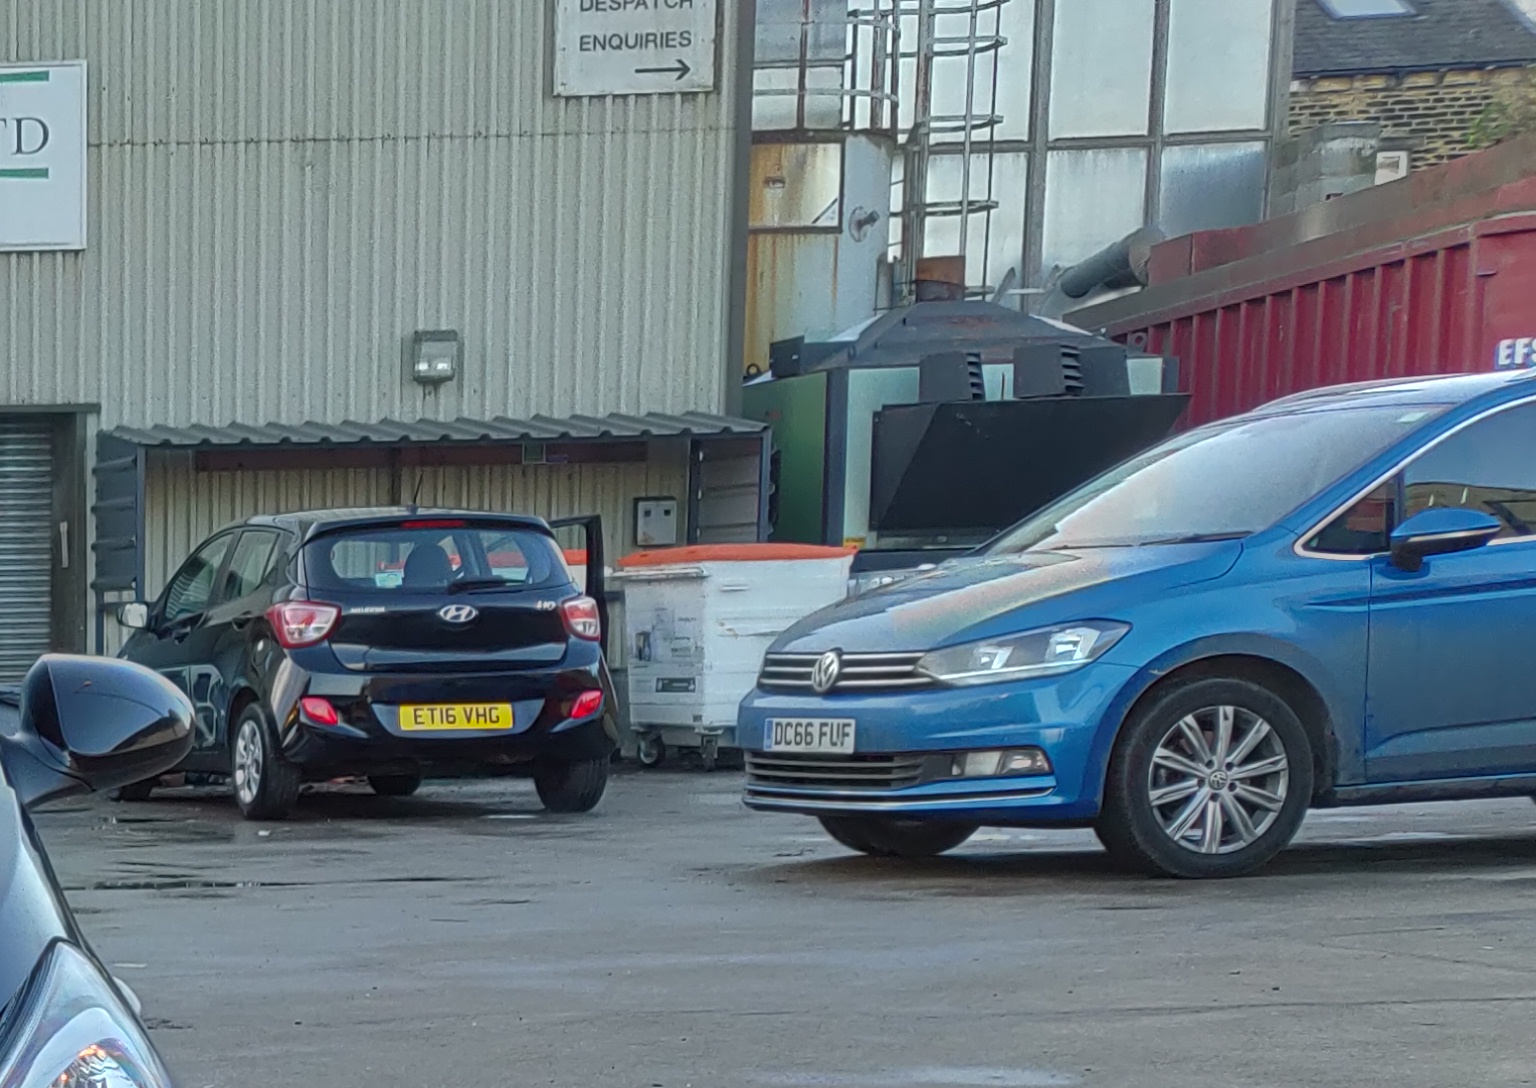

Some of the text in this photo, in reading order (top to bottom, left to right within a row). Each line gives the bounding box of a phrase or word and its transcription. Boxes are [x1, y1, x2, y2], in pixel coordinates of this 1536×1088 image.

[579, 31, 692, 52] ENQUIRIES
[1498, 337, 1536, 366] EF
[413, 706, 501, 725] ET16 VHG
[774, 721, 852, 747] DC66 FUF
